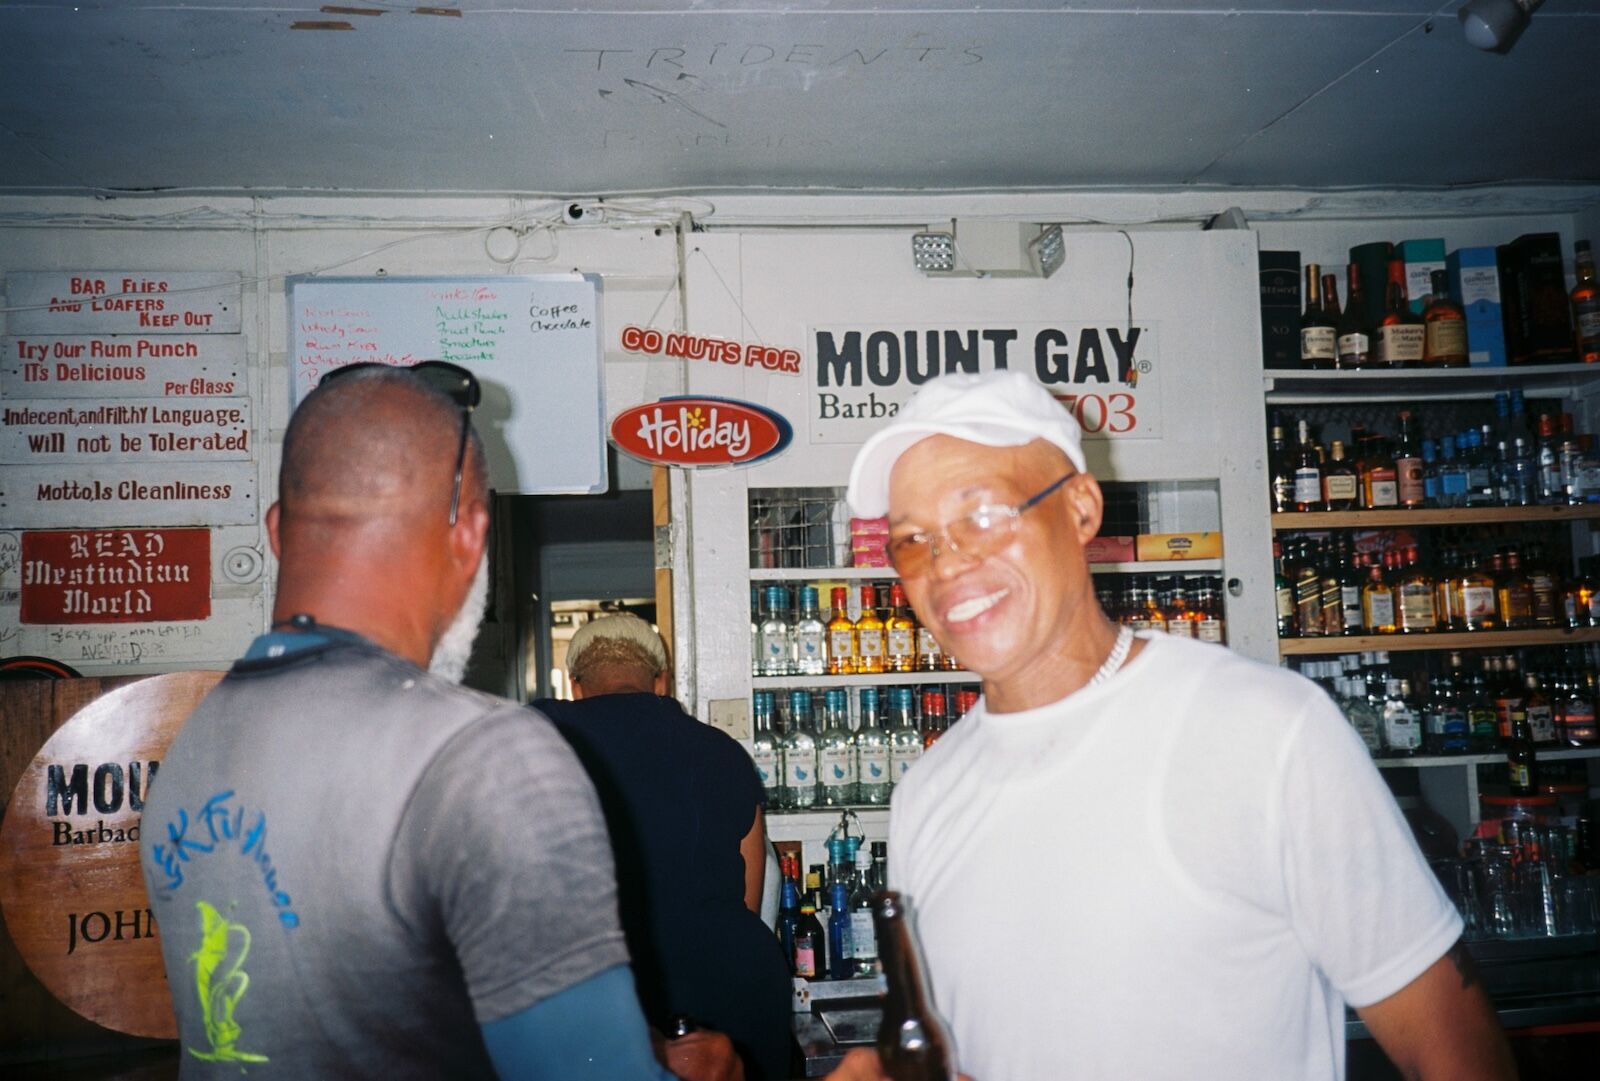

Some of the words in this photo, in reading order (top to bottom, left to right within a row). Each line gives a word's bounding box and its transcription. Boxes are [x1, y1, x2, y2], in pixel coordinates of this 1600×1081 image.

[71, 277, 106, 294] BAR
[49, 297, 82, 312] AND
[92, 296, 165, 312] LOAFERS
[529, 304, 578, 319] Coffee
[140, 312, 179, 327] KEEP
[184, 312, 213, 326] OUT
[530, 318, 592, 333] Chocolate
[17, 341, 49, 361] Try
[54, 342, 86, 359] Our
[91, 341, 132, 358] Rum
[137, 340, 198, 357] Punch
[622, 327, 662, 353] GO
[666, 334, 741, 365] NUTS
[745, 345, 801, 373] FOR
[816, 329, 1017, 386] MOUNT
[1034, 327, 1141, 384] GAY
[56, 363, 146, 381] Delicious
[165, 381, 189, 395] Per
[190, 378, 234, 395] Glass
[28, 432, 65, 453] Will
[77, 434, 111, 453] not
[121, 432, 142, 452] be
[148, 429, 248, 452] Tolerated
[637, 407, 750, 456] Holiday
[118, 480, 232, 500] Cleanliness
[70, 532, 164, 558] READ
[62, 588, 152, 614] World
